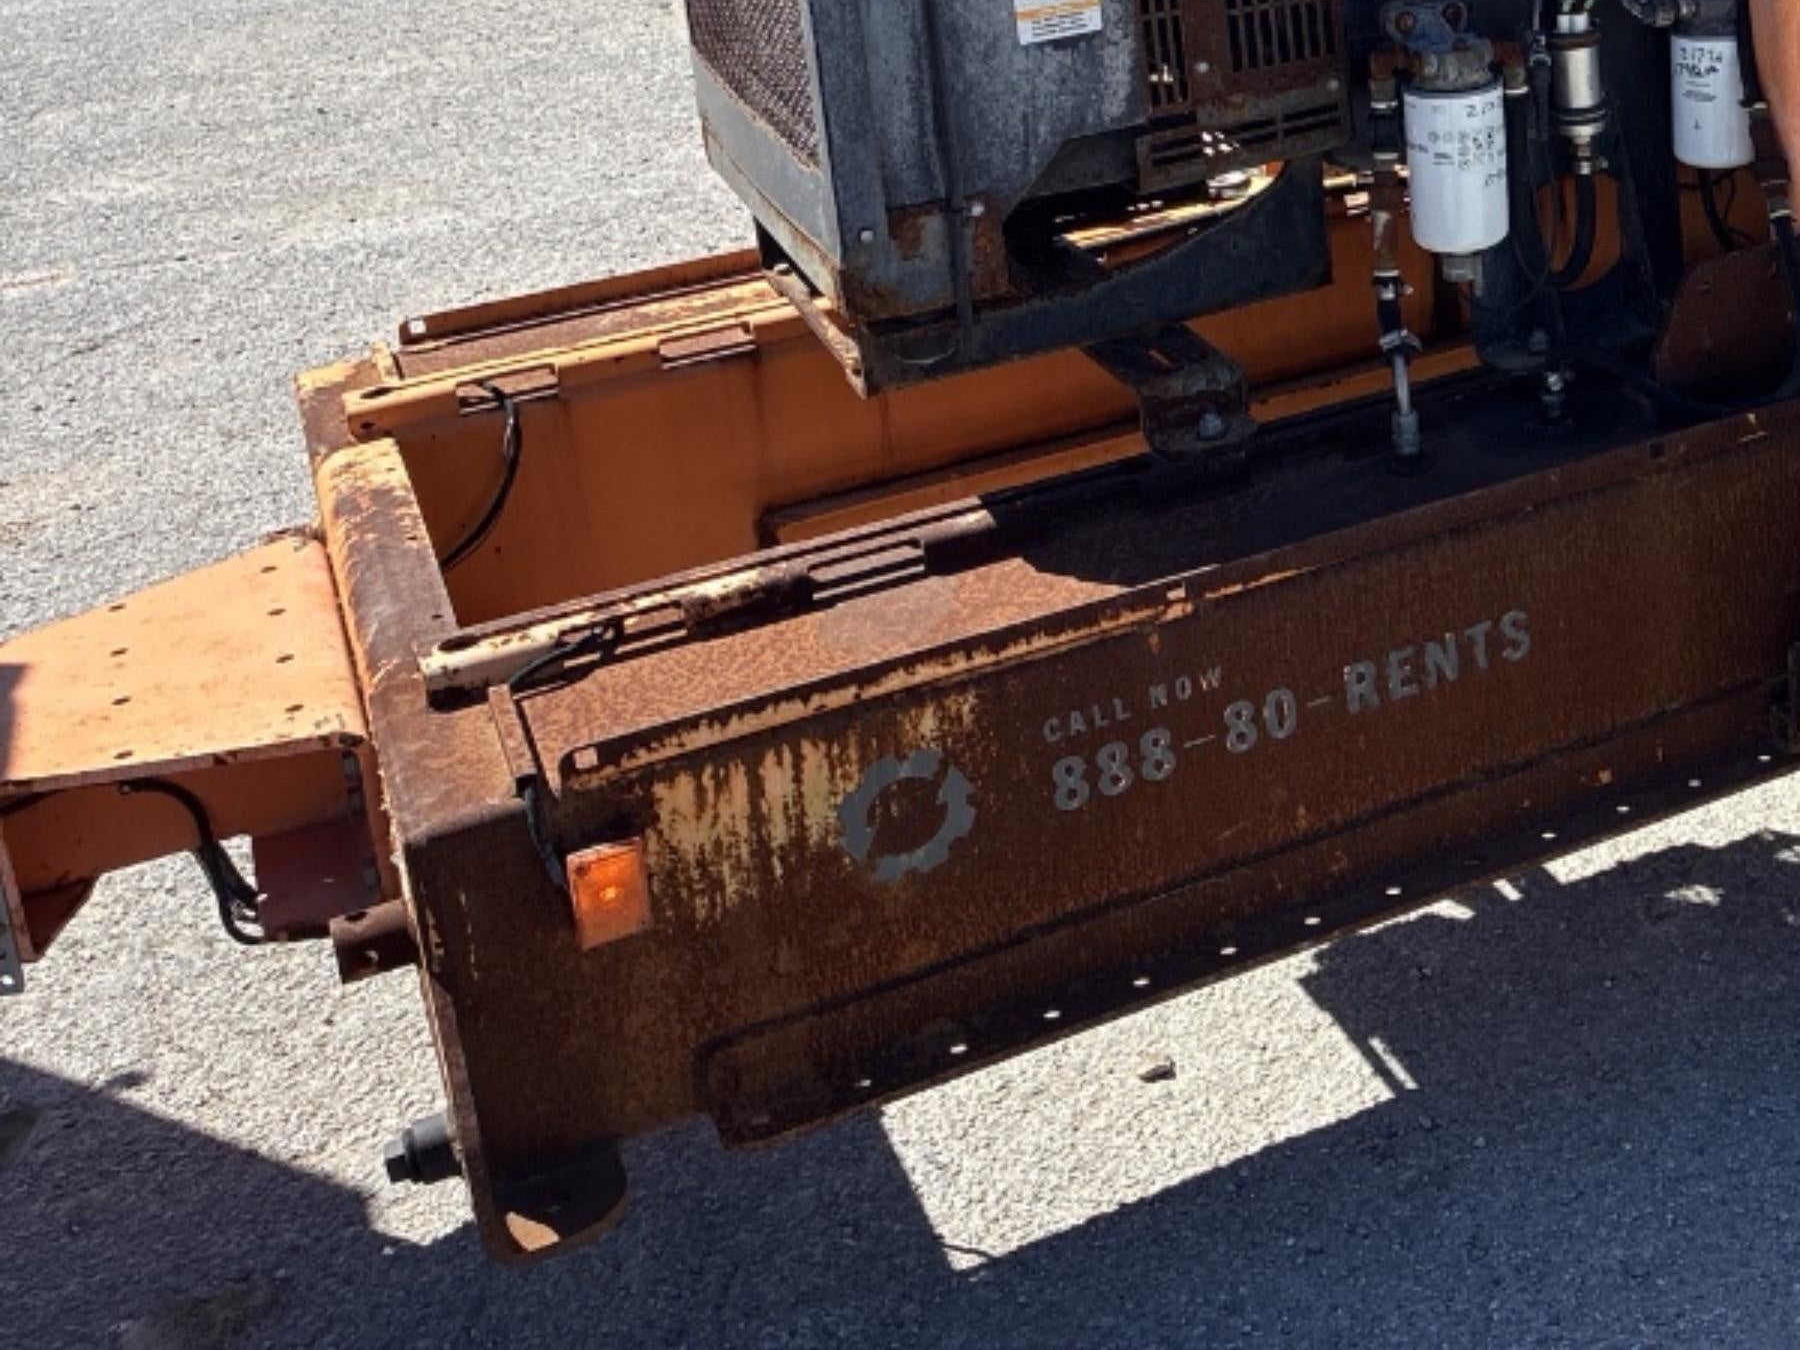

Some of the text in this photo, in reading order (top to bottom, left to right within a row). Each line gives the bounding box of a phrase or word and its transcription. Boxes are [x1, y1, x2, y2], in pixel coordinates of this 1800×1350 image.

[1042, 665, 1224, 744] CALL NOW
[1051, 608, 1533, 812] 888-80-RENTS
